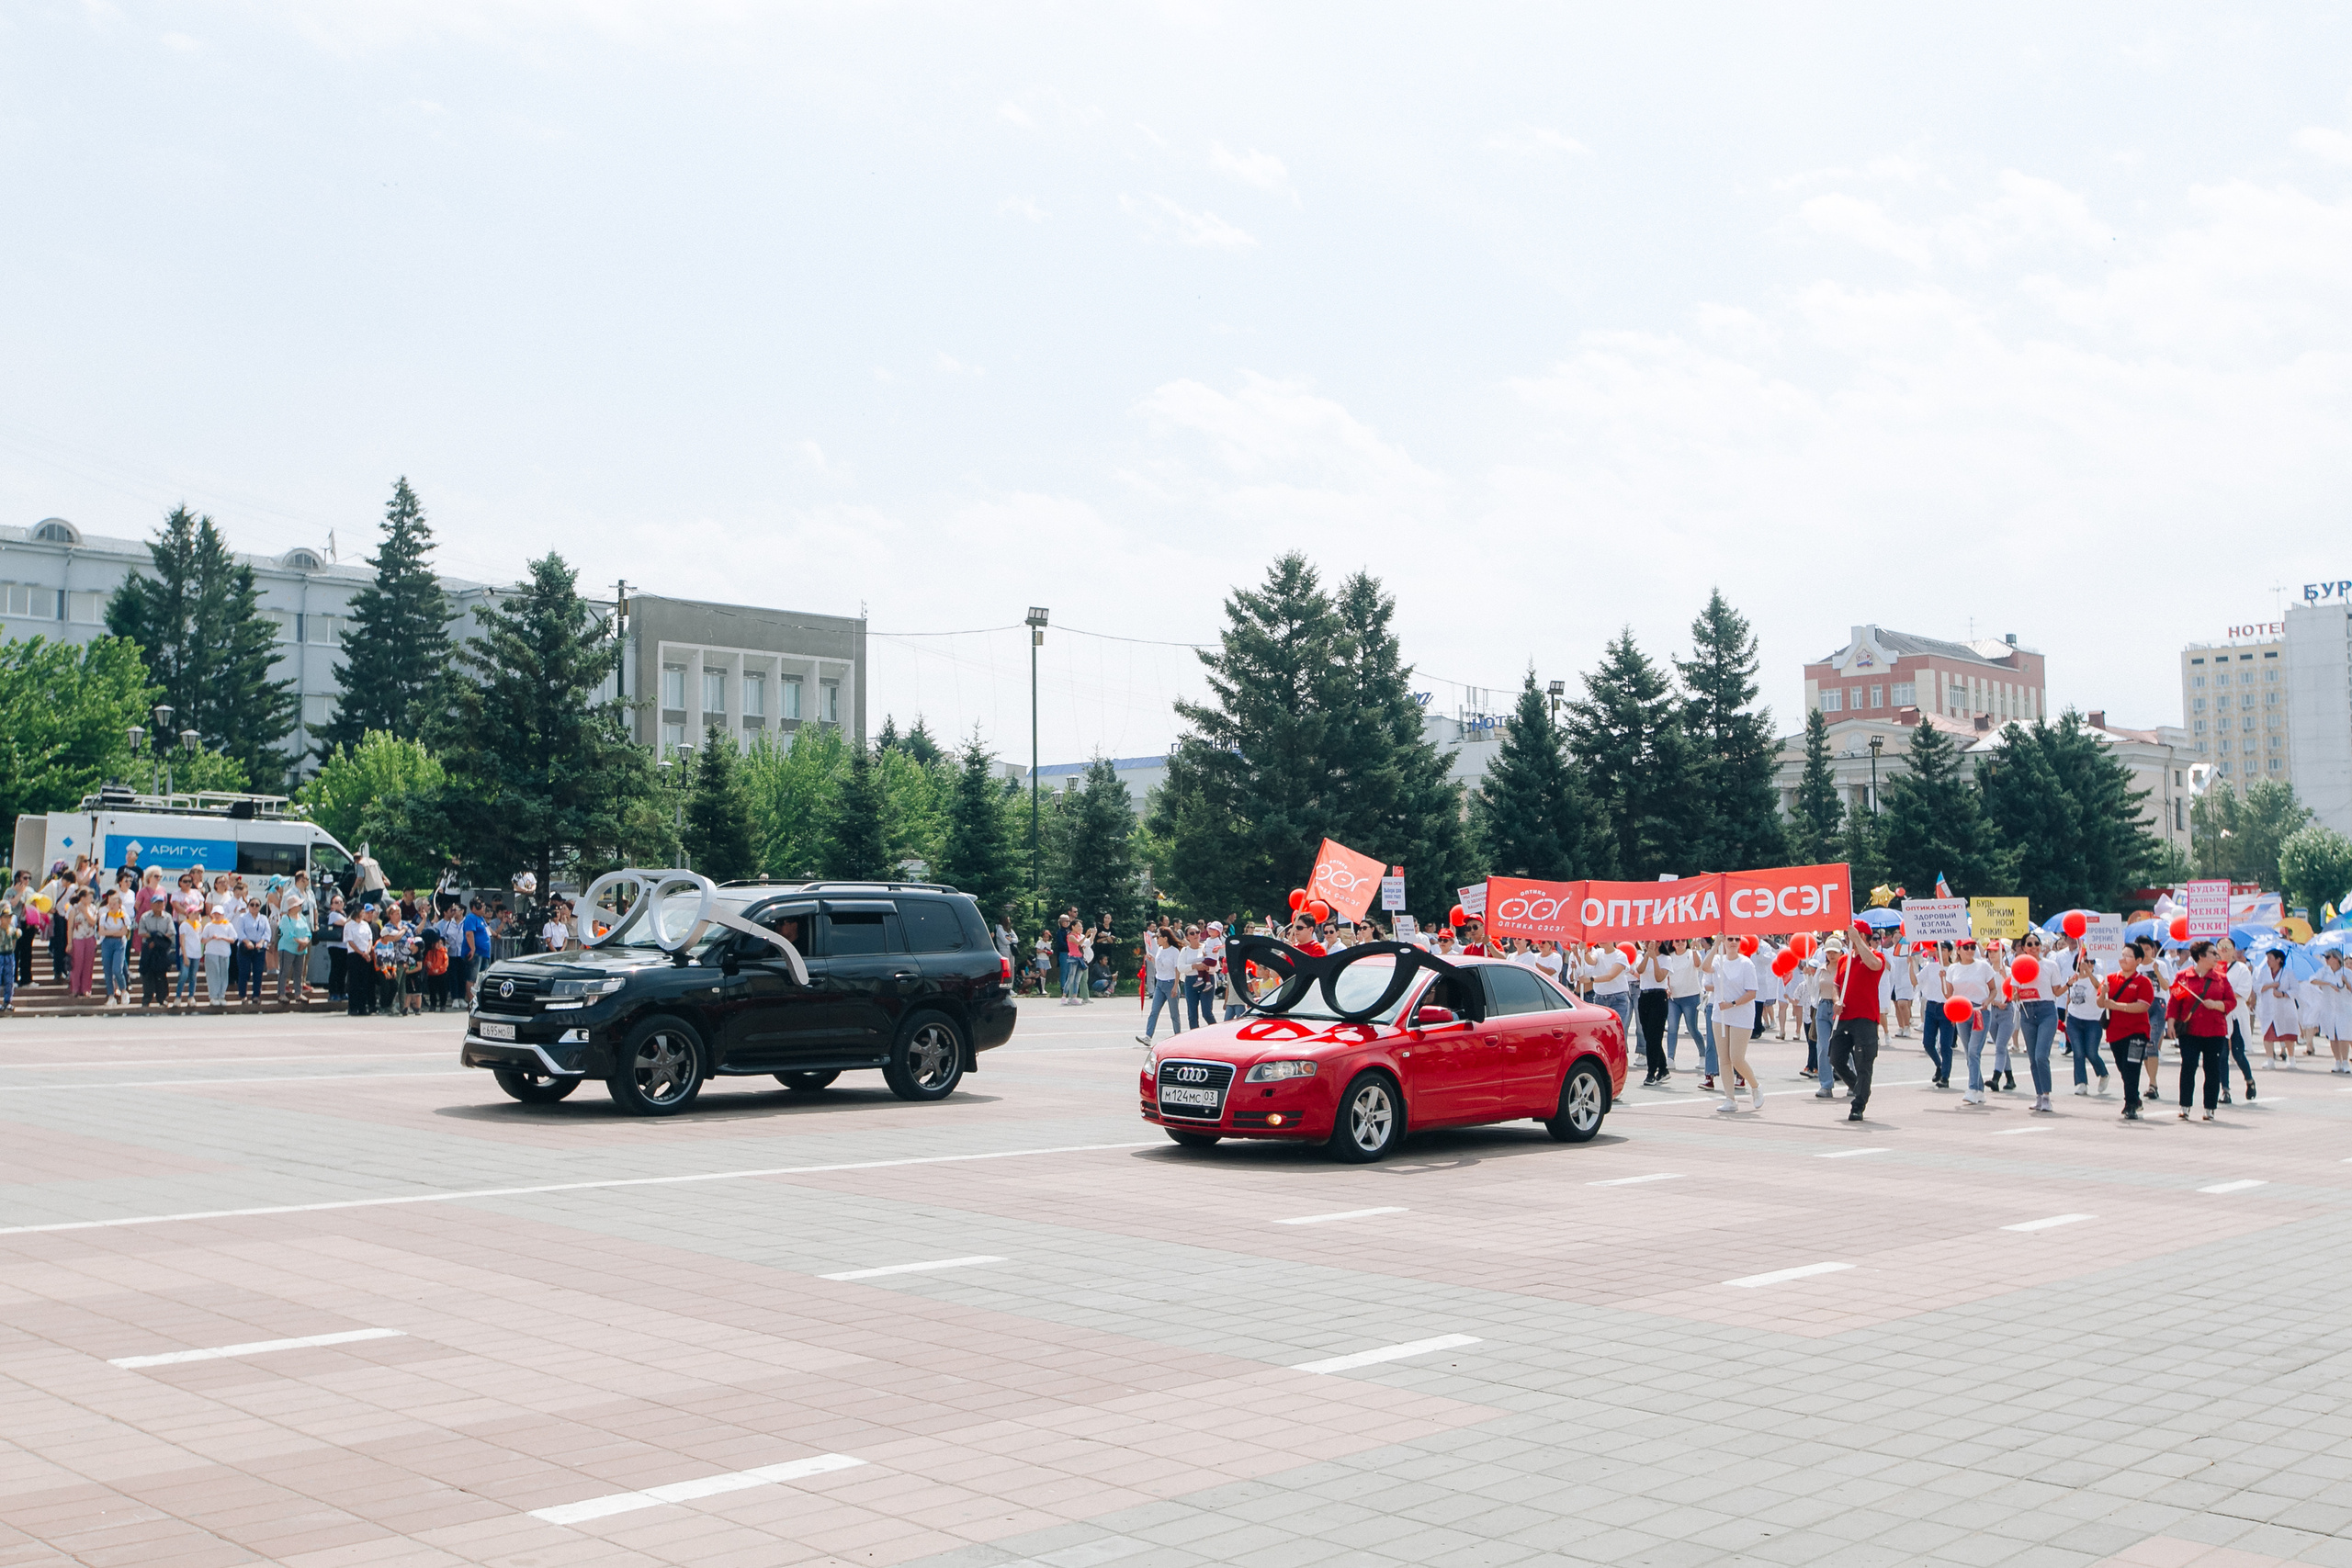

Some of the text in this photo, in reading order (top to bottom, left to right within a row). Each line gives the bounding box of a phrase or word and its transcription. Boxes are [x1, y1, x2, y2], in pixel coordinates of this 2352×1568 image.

[150, 844, 208, 857] АРИГУС
[2189, 886, 2228, 894] БУДЬТЕ
[1580, 883, 1838, 928] ОПТИКА СЭСЭГ
[1976, 899, 1995, 908] БУДЬ
[1914, 912, 1957, 921] ЗДОРОВЫЙ
[1986, 908, 2015, 918] ЯРКИМ
[2189, 908, 2227, 916] МЕНЯЯ
[1498, 920, 1566, 932] ОПТИКА СЭСЭГ
[2189, 922, 2227, 931] ОЧКИ!
[1980, 928, 2002, 936] ОЧКИ!
[1204, 1091, 1215, 1101] 03
